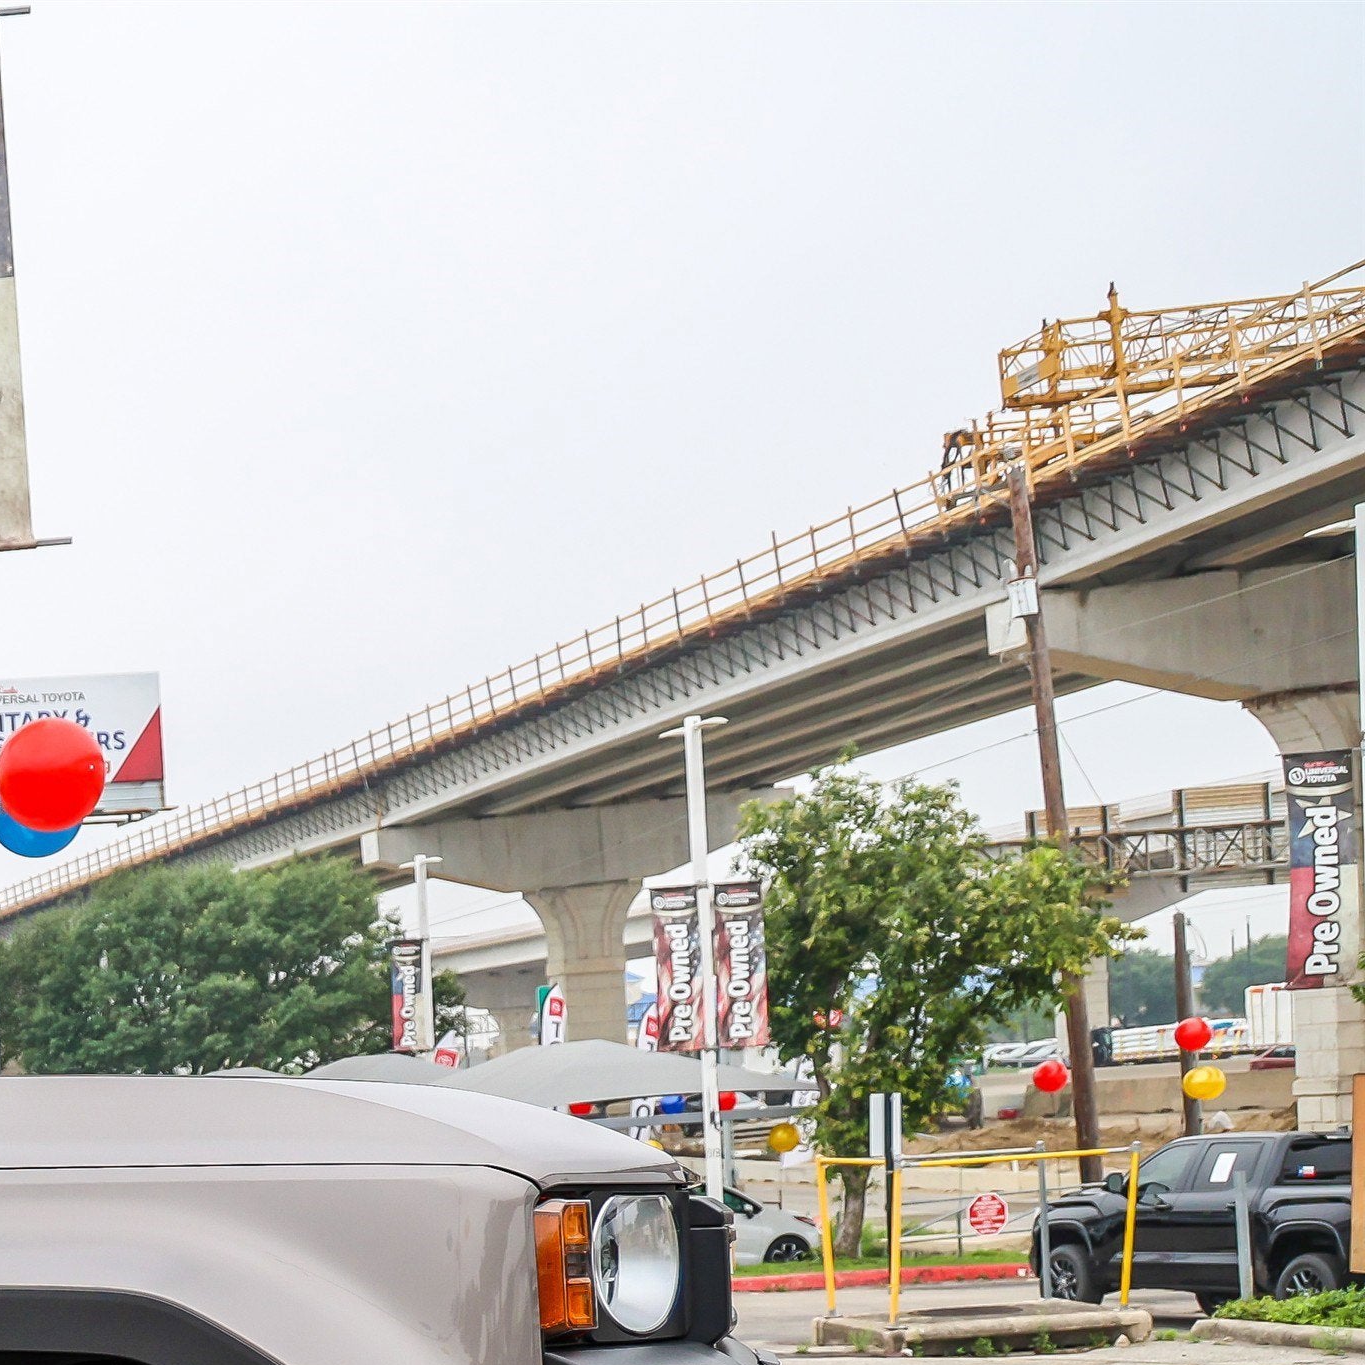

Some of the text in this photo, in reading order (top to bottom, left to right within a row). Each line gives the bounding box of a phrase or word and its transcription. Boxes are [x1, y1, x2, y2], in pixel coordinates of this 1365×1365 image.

[42, 692, 86, 703] TOYOTA
[1306, 805, 1341, 916] Owned
[664, 923, 692, 1001] Owned
[725, 920, 751, 998] Owned
[1305, 921, 1340, 975] Pre
[670, 1003, 693, 1042] Pre
[729, 1000, 753, 1039] Pre
